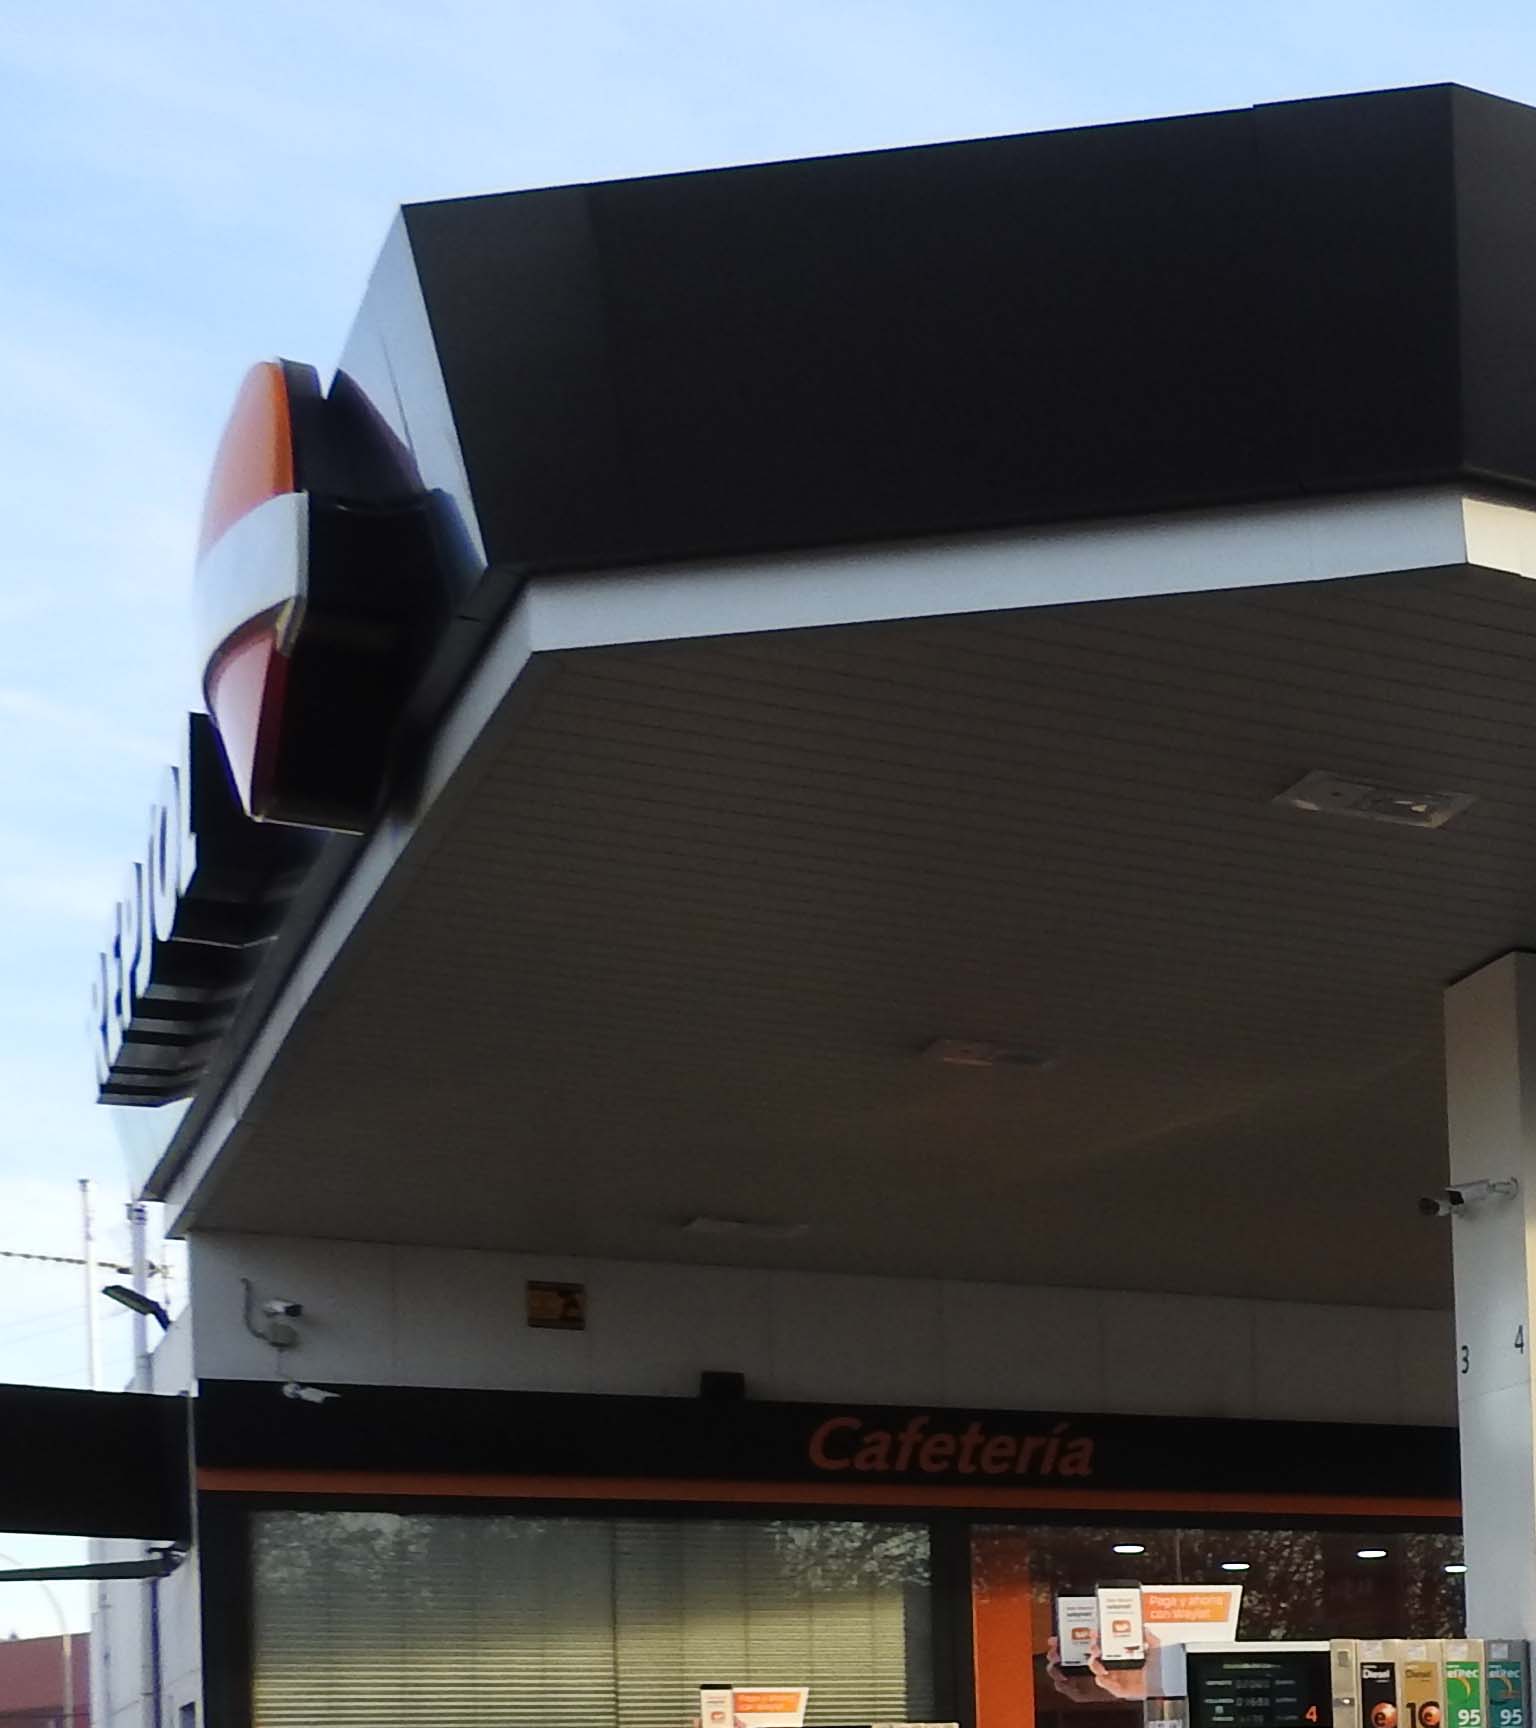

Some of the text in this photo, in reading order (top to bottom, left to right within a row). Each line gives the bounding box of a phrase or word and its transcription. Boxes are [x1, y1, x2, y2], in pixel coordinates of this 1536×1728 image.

[1514, 1325, 1524, 1354] 4
[1461, 1345, 1469, 1374] 3
[809, 1415, 1095, 1477] Cafetería
[1305, 1705, 1318, 1722] 4
[1458, 1709, 1481, 1726] 95
[1500, 1709, 1522, 1726] 95
